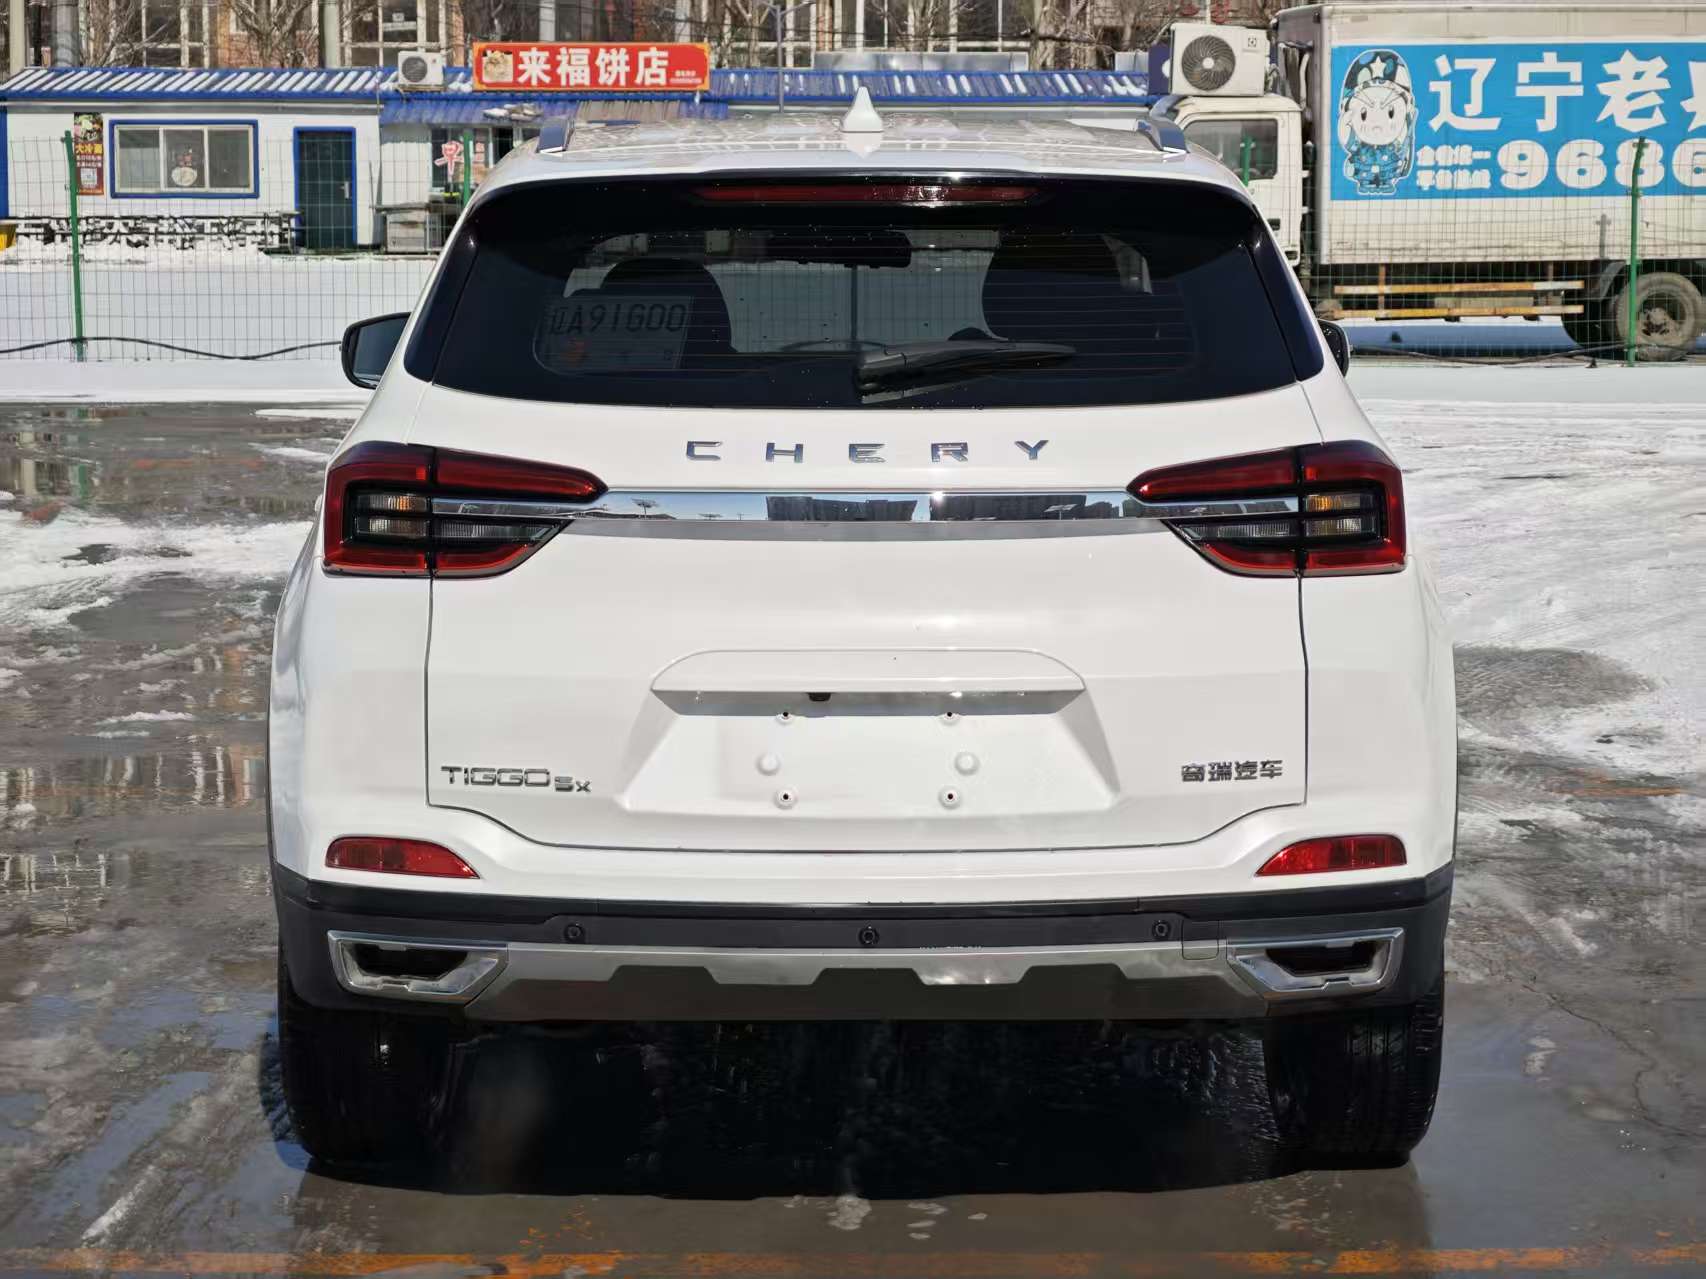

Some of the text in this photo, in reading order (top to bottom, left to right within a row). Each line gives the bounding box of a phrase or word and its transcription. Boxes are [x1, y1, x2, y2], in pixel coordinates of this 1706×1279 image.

[517, 48, 669, 86] 来福饼店
[1497, 138, 1706, 190] 9686
[686, 440, 1050, 463] CHERY
[1181, 760, 1282, 782] 奇瑞汽车
